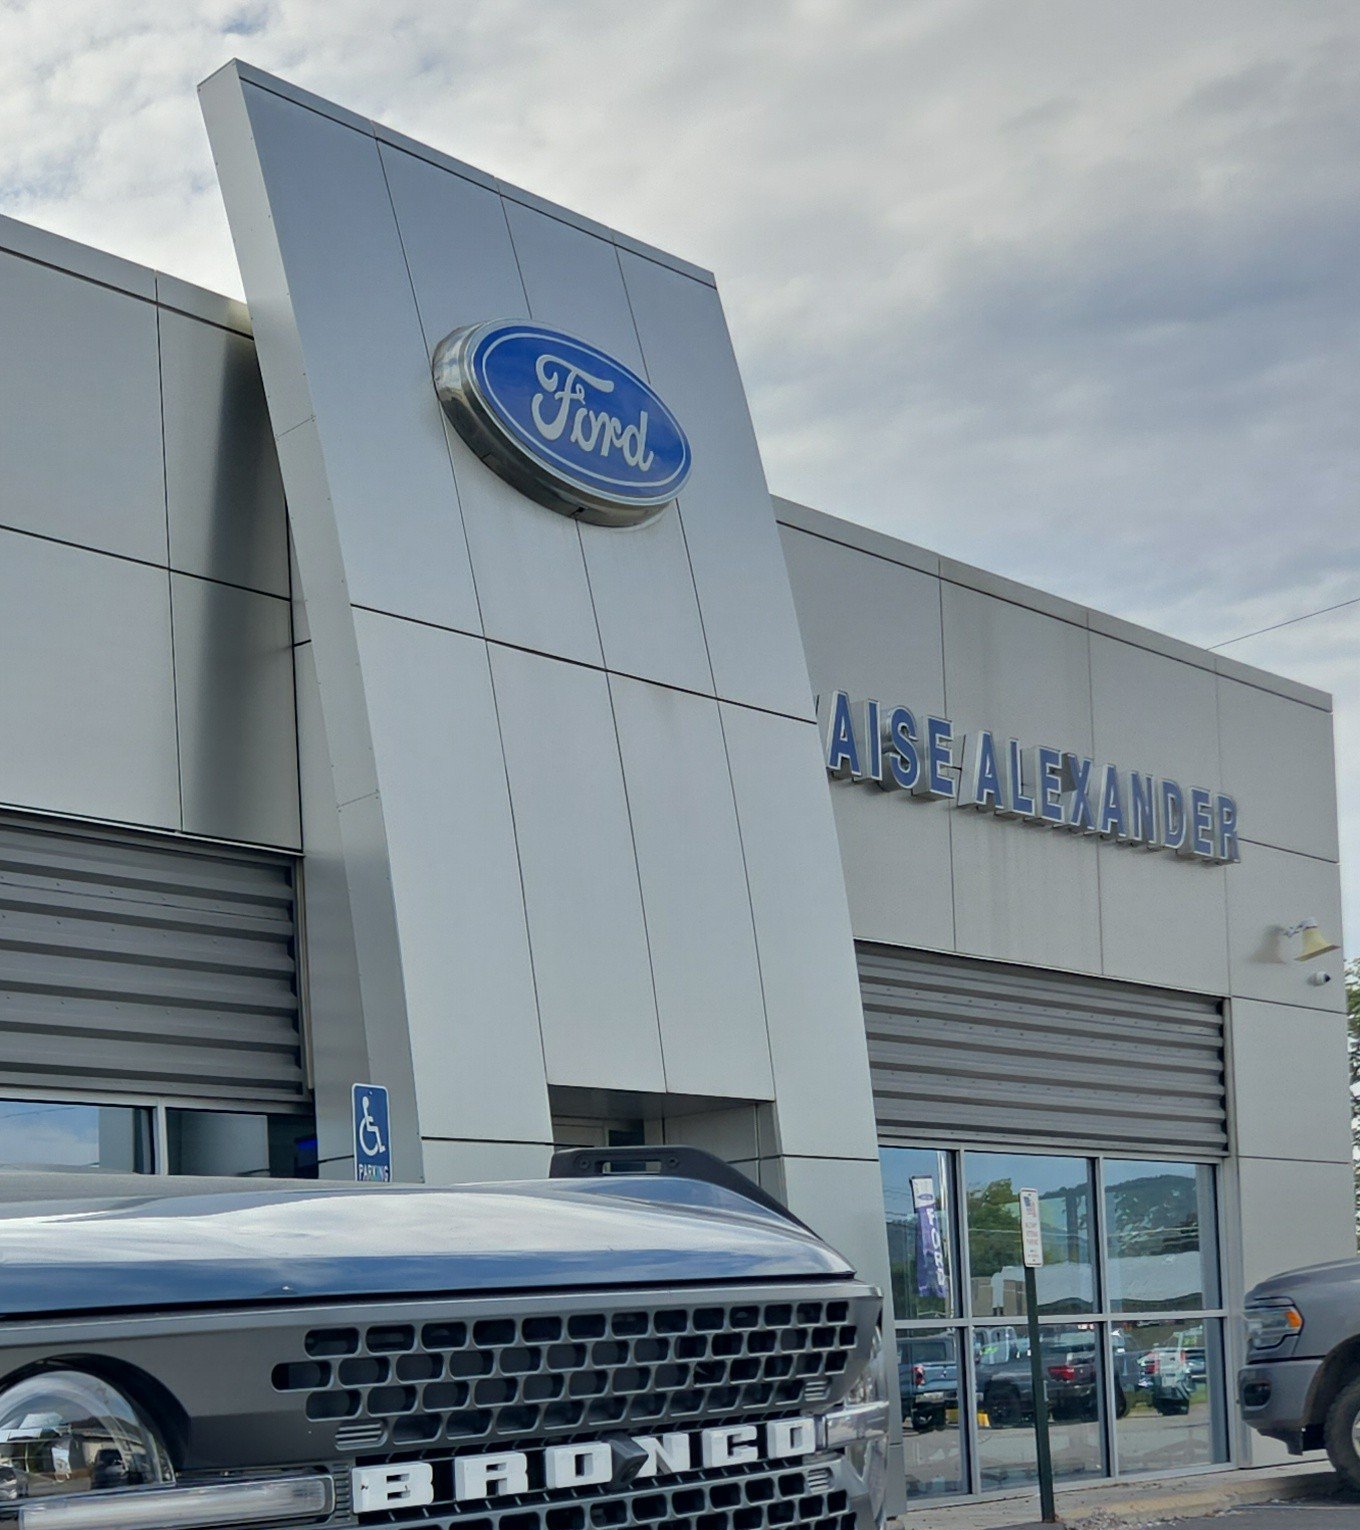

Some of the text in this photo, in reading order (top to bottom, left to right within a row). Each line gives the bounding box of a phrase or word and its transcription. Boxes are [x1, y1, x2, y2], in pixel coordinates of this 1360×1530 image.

[531, 353, 654, 473] Ford
[972, 730, 1241, 863] ALEXANDER
[351, 1416, 817, 1515] BRONCO
